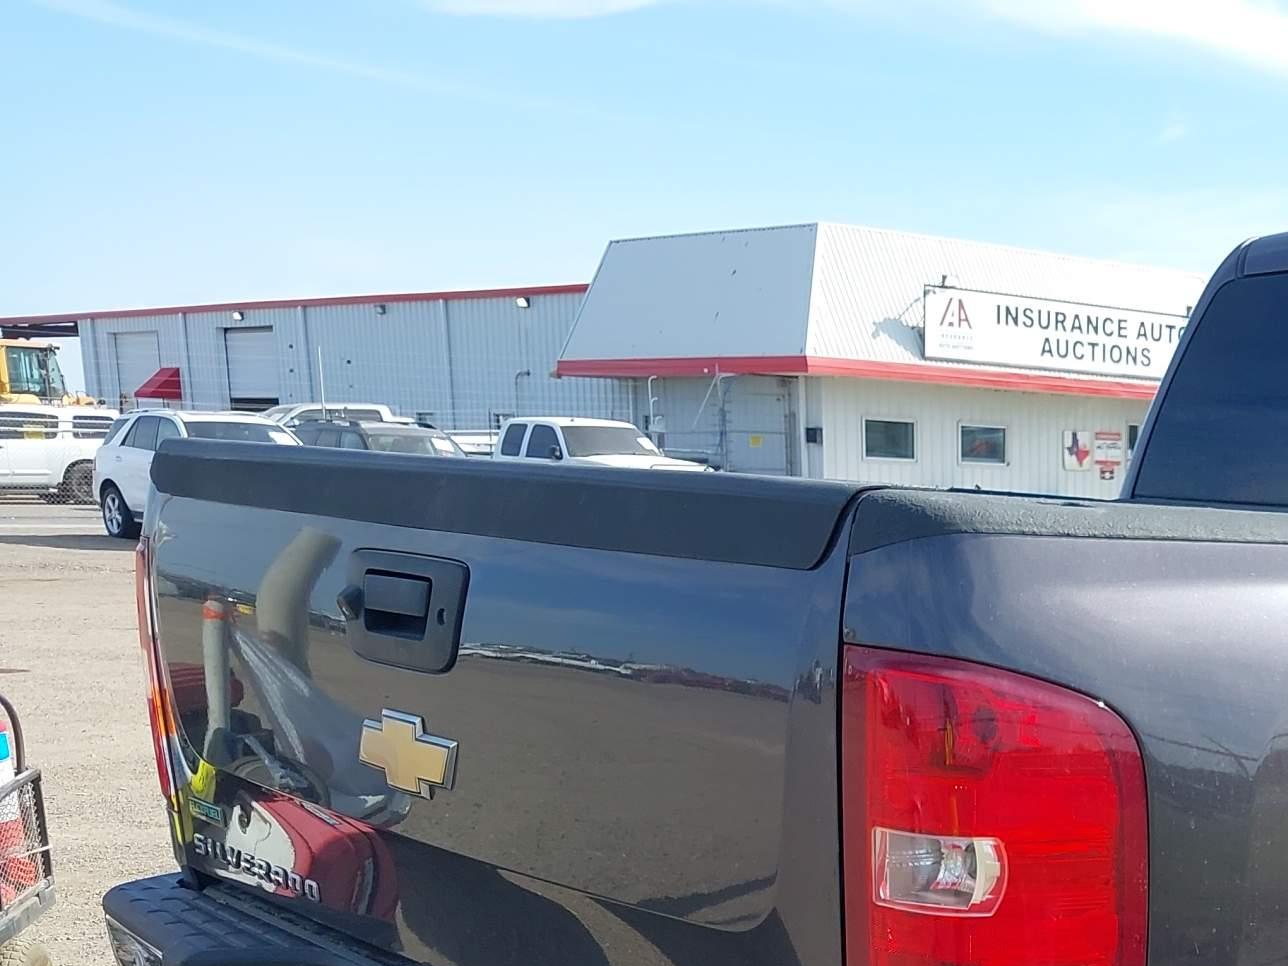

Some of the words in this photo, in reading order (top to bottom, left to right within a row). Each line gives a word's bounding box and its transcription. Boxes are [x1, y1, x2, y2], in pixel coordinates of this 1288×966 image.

[996, 304, 1128, 338] INSURANCE
[1041, 337, 1152, 367] AUCTIONS
[193, 832, 321, 902] SILVERADO
